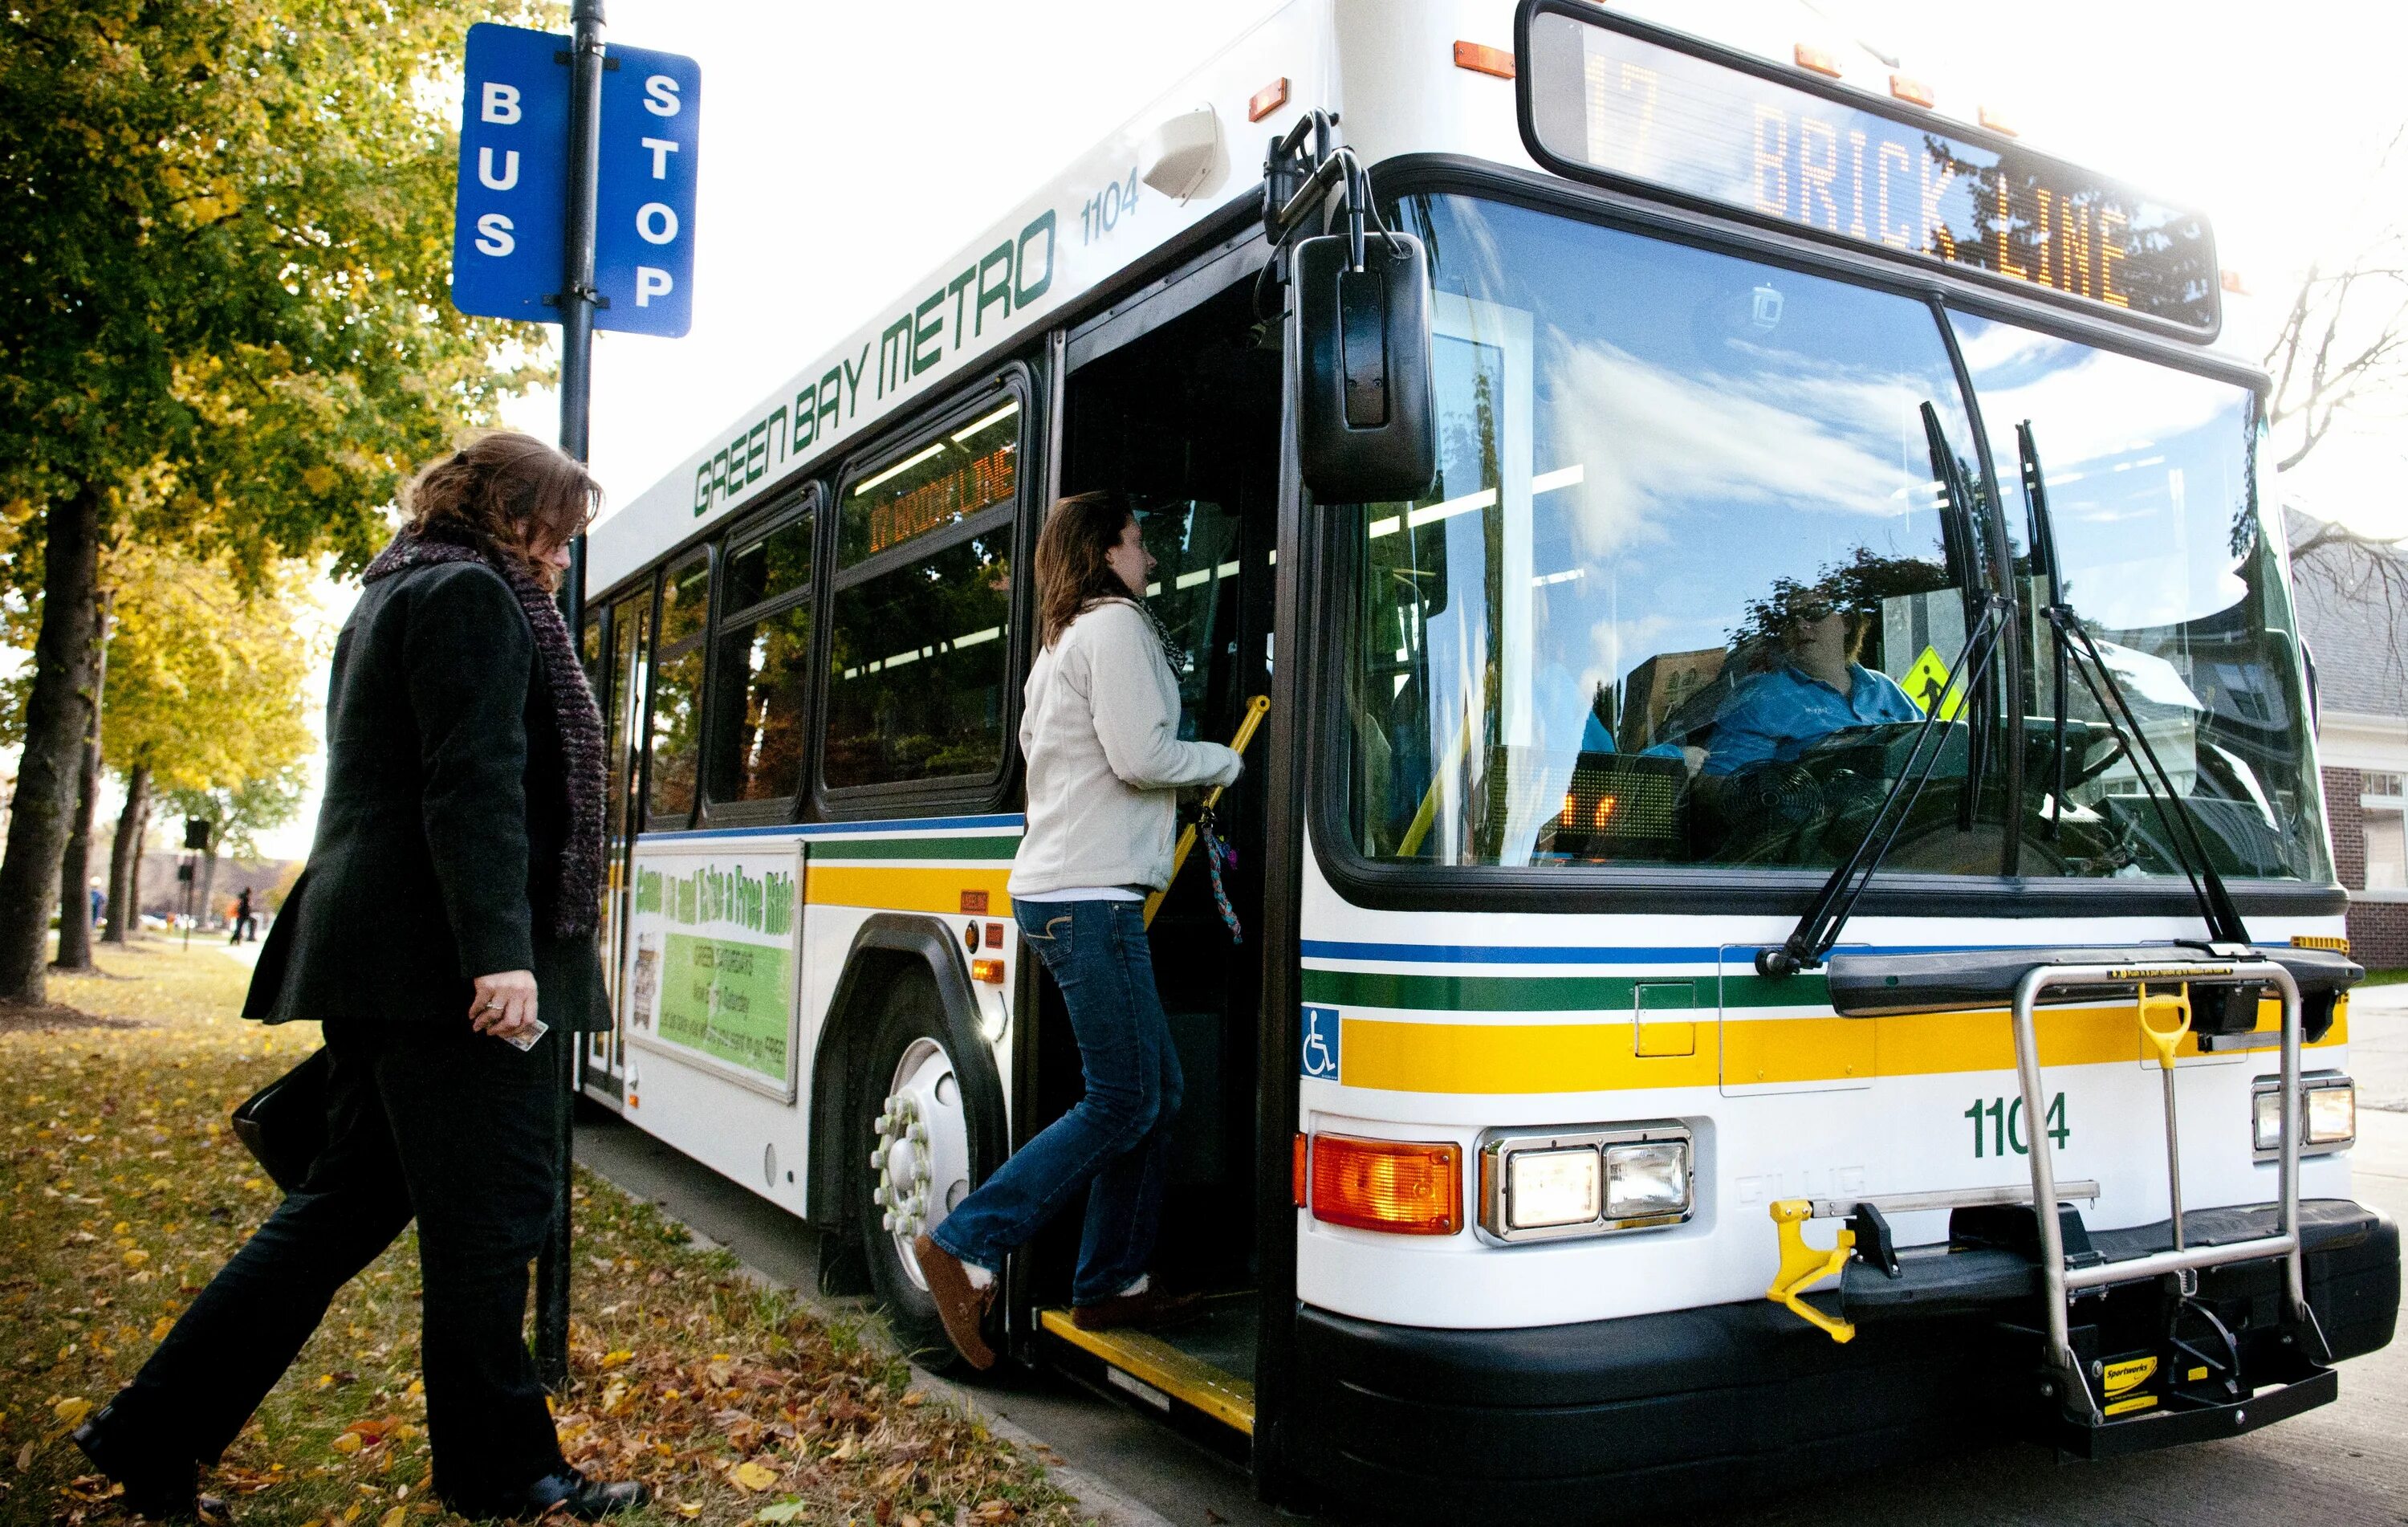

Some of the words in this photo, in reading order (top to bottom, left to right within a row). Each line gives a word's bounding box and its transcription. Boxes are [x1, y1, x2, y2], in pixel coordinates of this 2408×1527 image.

[475, 82, 522, 257] BUS
[636, 75, 681, 307] STOP
[1080, 166, 1140, 246] 1104
[1754, 103, 1955, 263] BRICK
[1998, 173, 2129, 307] LINE
[694, 404, 788, 518] GREEN
[793, 343, 871, 455] BAY
[877, 208, 1057, 400] METRO
[959, 446, 1015, 514] LINE
[734, 865, 763, 932] Free
[764, 871, 794, 936] Ride
[1964, 1092, 2070, 1158] 1104
[2106, 1363, 2148, 1380] Sportworks
